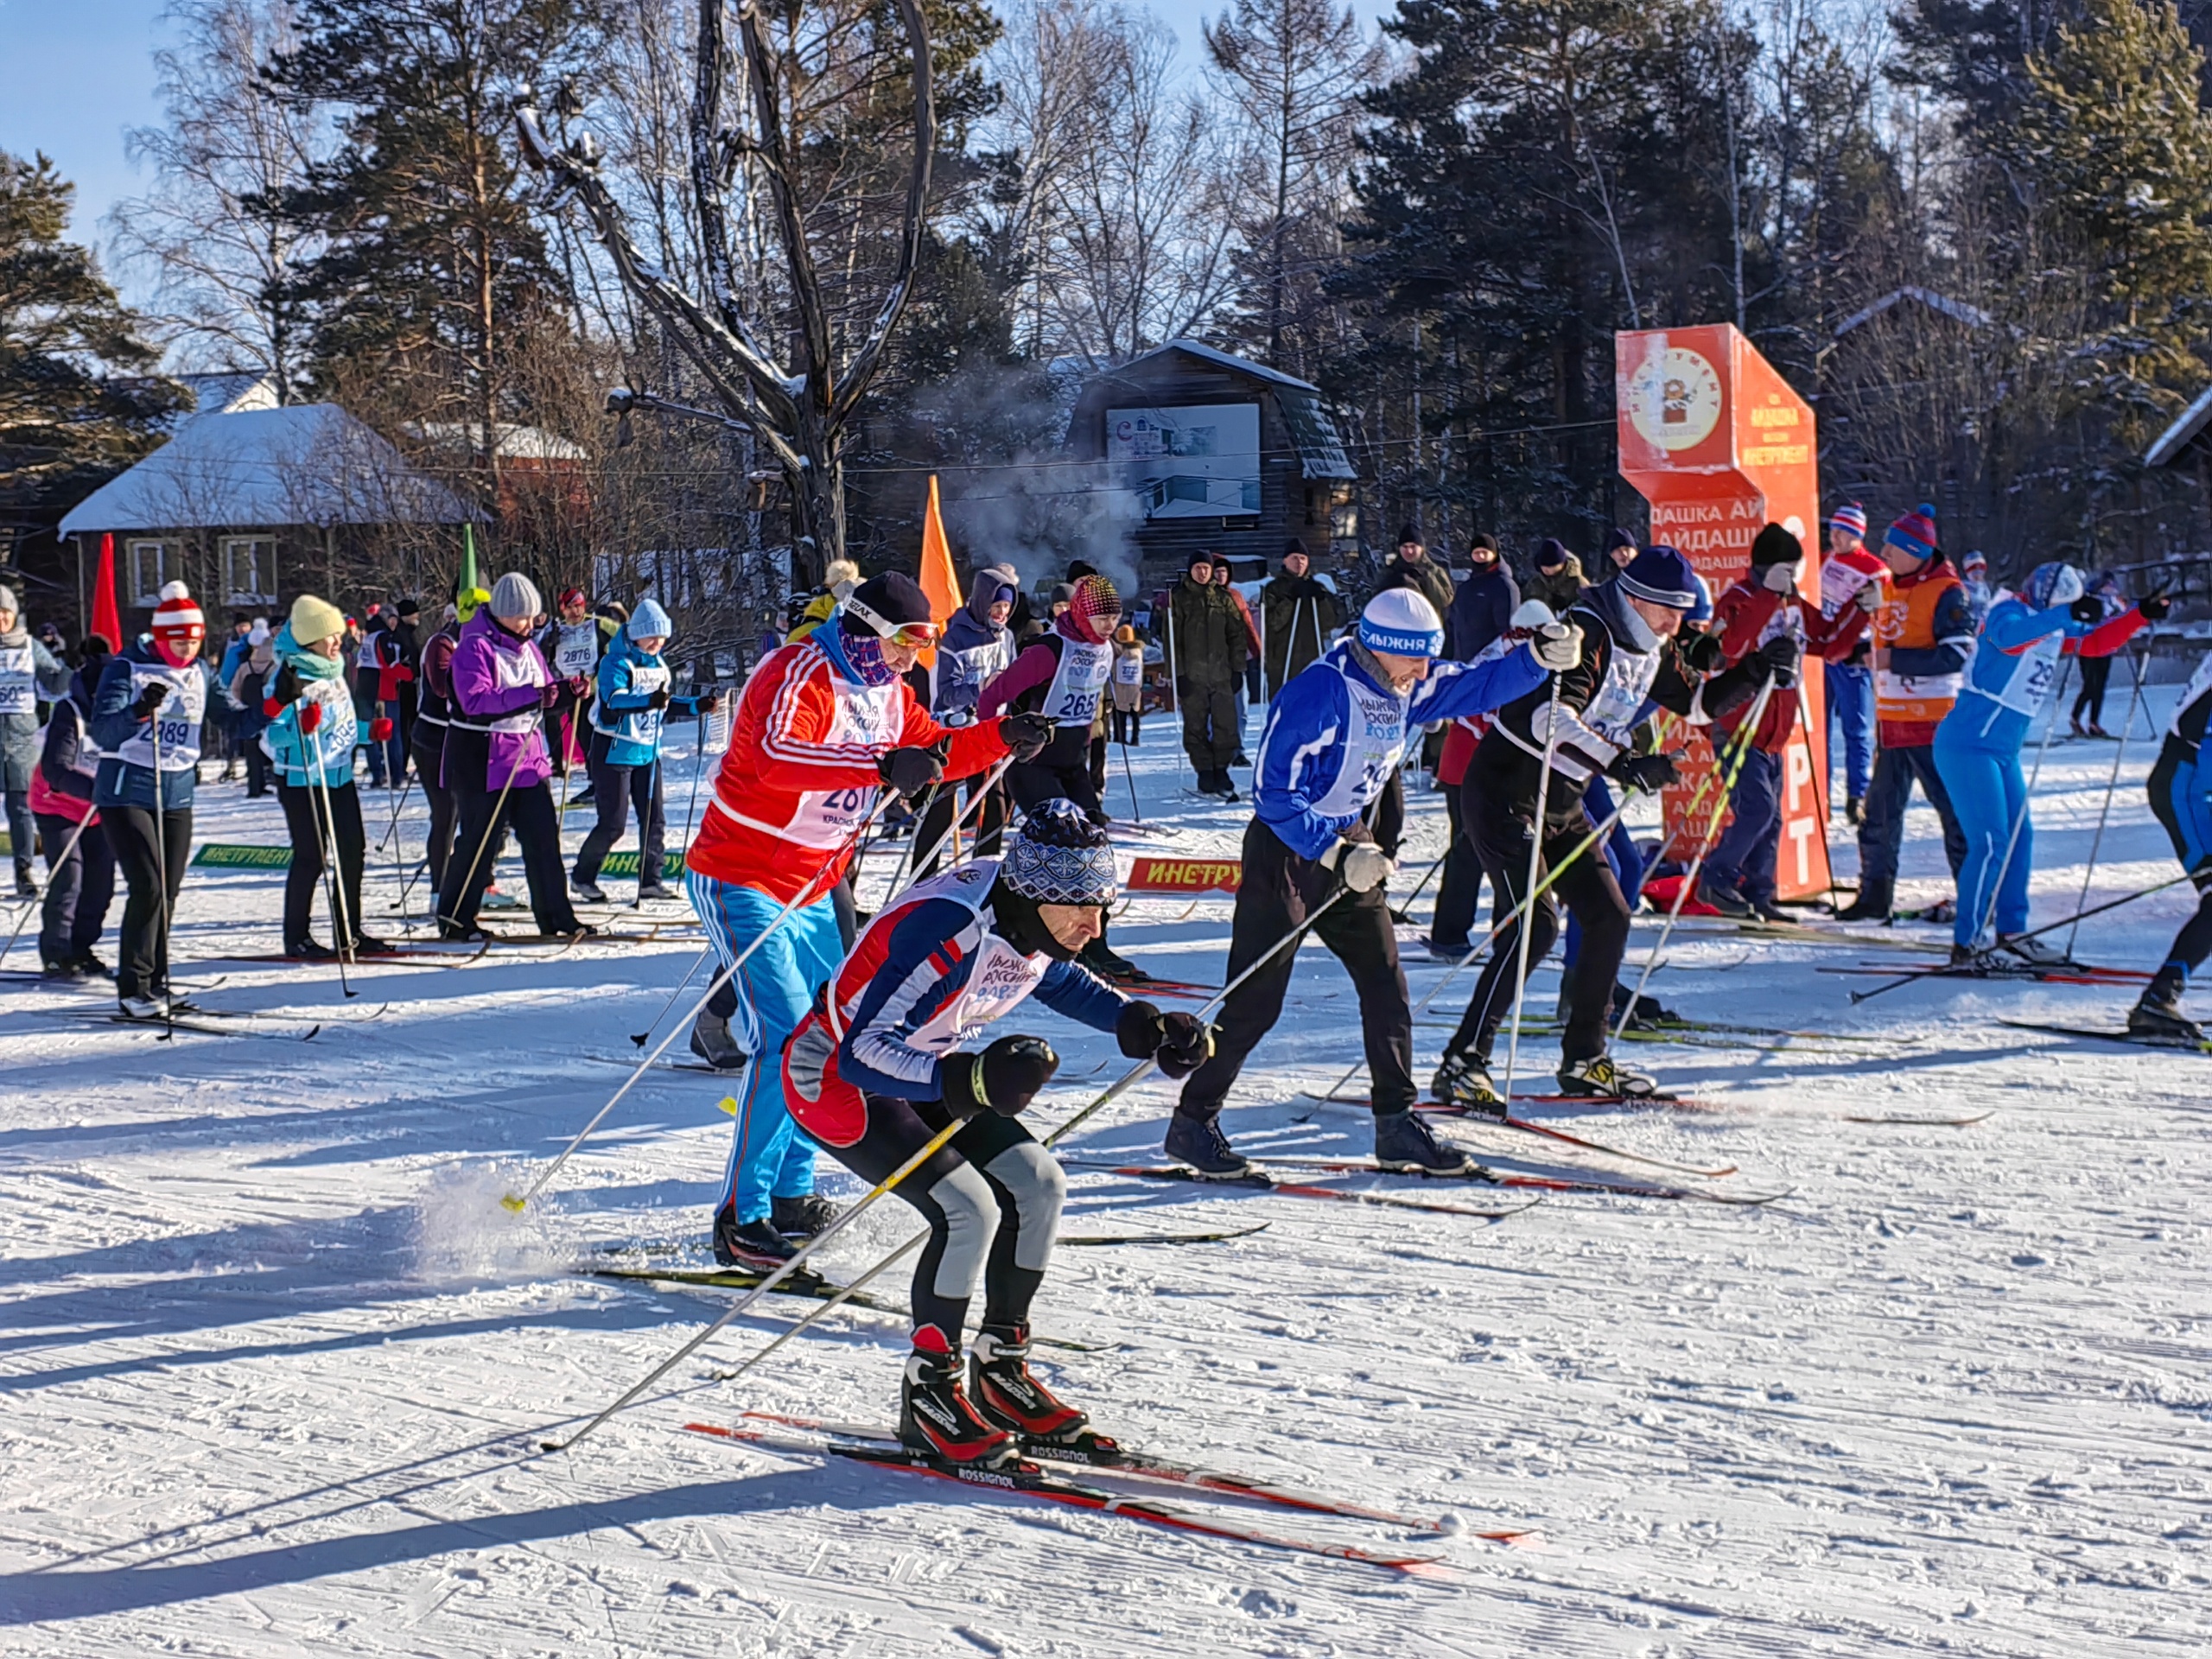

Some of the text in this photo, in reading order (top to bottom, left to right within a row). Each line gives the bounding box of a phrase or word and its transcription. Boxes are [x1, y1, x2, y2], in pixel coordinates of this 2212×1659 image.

[1658, 526, 1758, 553] АЙДАШ
[849, 600, 872, 620] RELAX
[1366, 632, 1426, 652] ЛЫЖНЯ
[1030, 1445, 1091, 1464] ROSSIGNOL
[958, 1467, 1015, 1489] ROSSIGNOL
